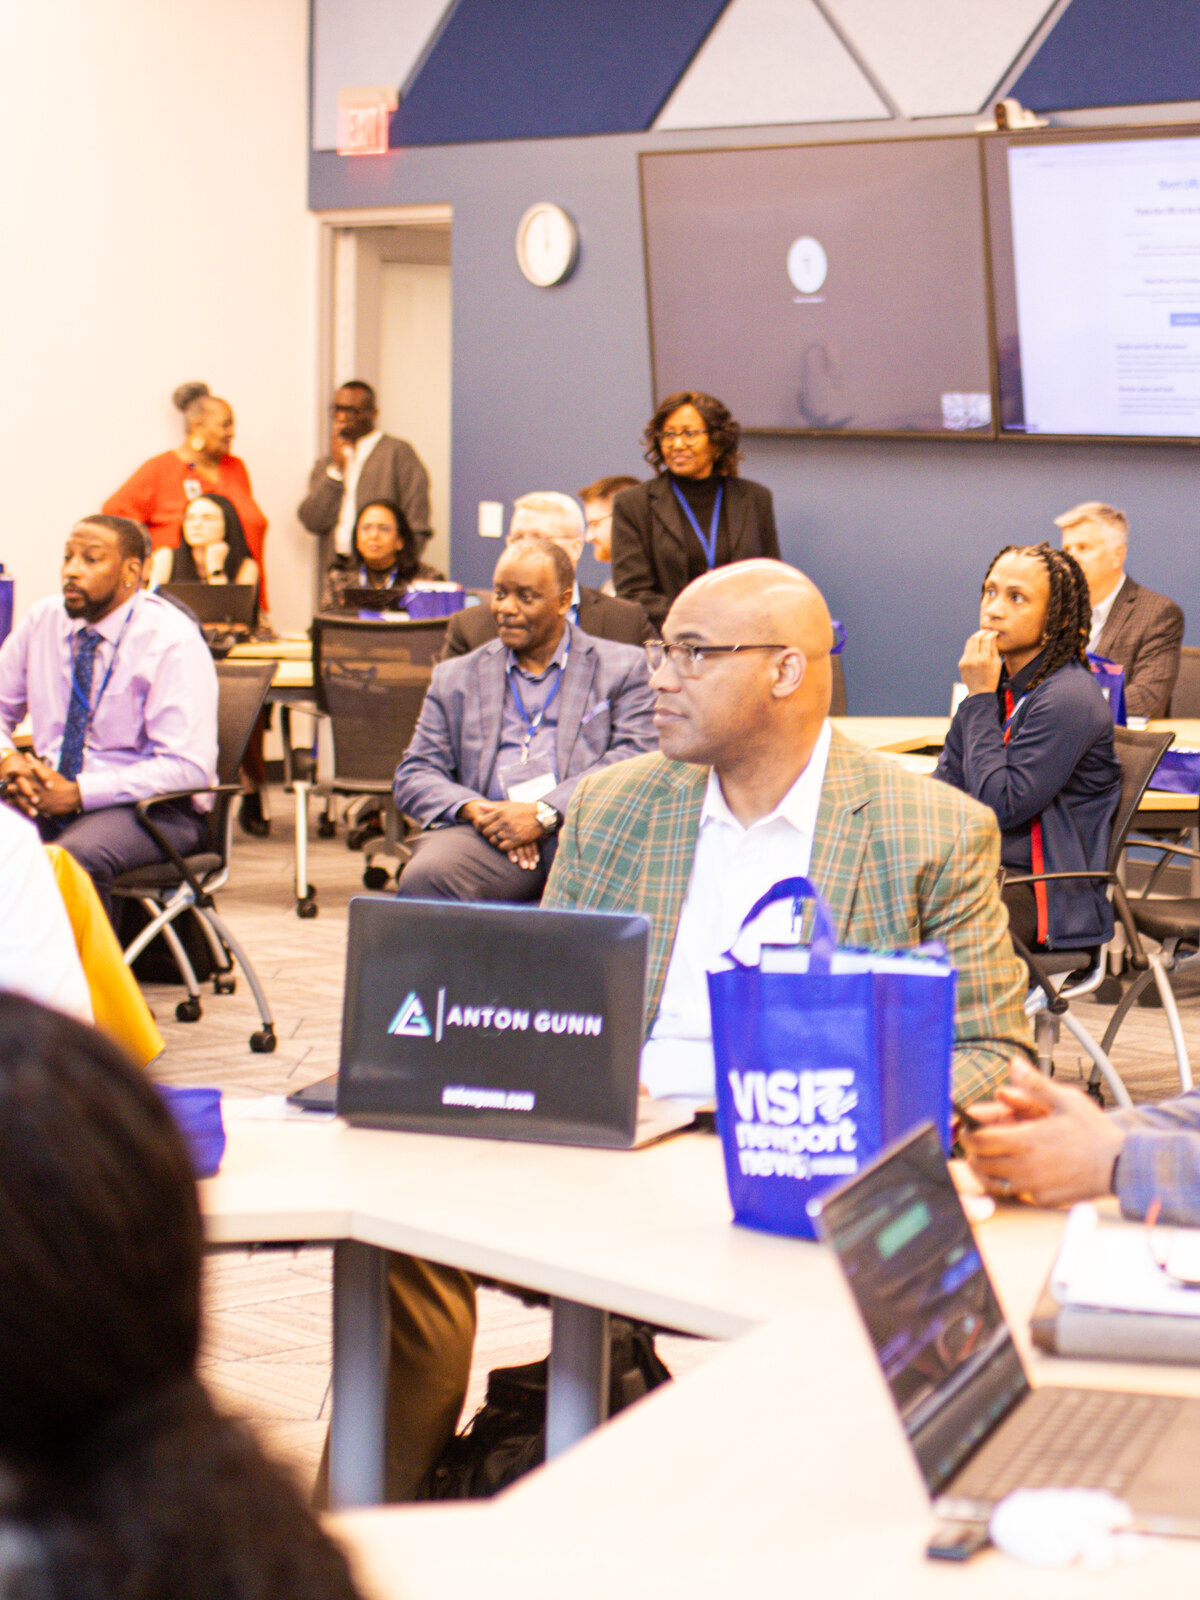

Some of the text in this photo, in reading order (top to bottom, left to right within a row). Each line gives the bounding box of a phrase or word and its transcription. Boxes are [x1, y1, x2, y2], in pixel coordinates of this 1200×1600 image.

[446, 1004, 602, 1036] ANTON GUNN
[735, 1117, 857, 1156] newport
[739, 1150, 808, 1180] news
